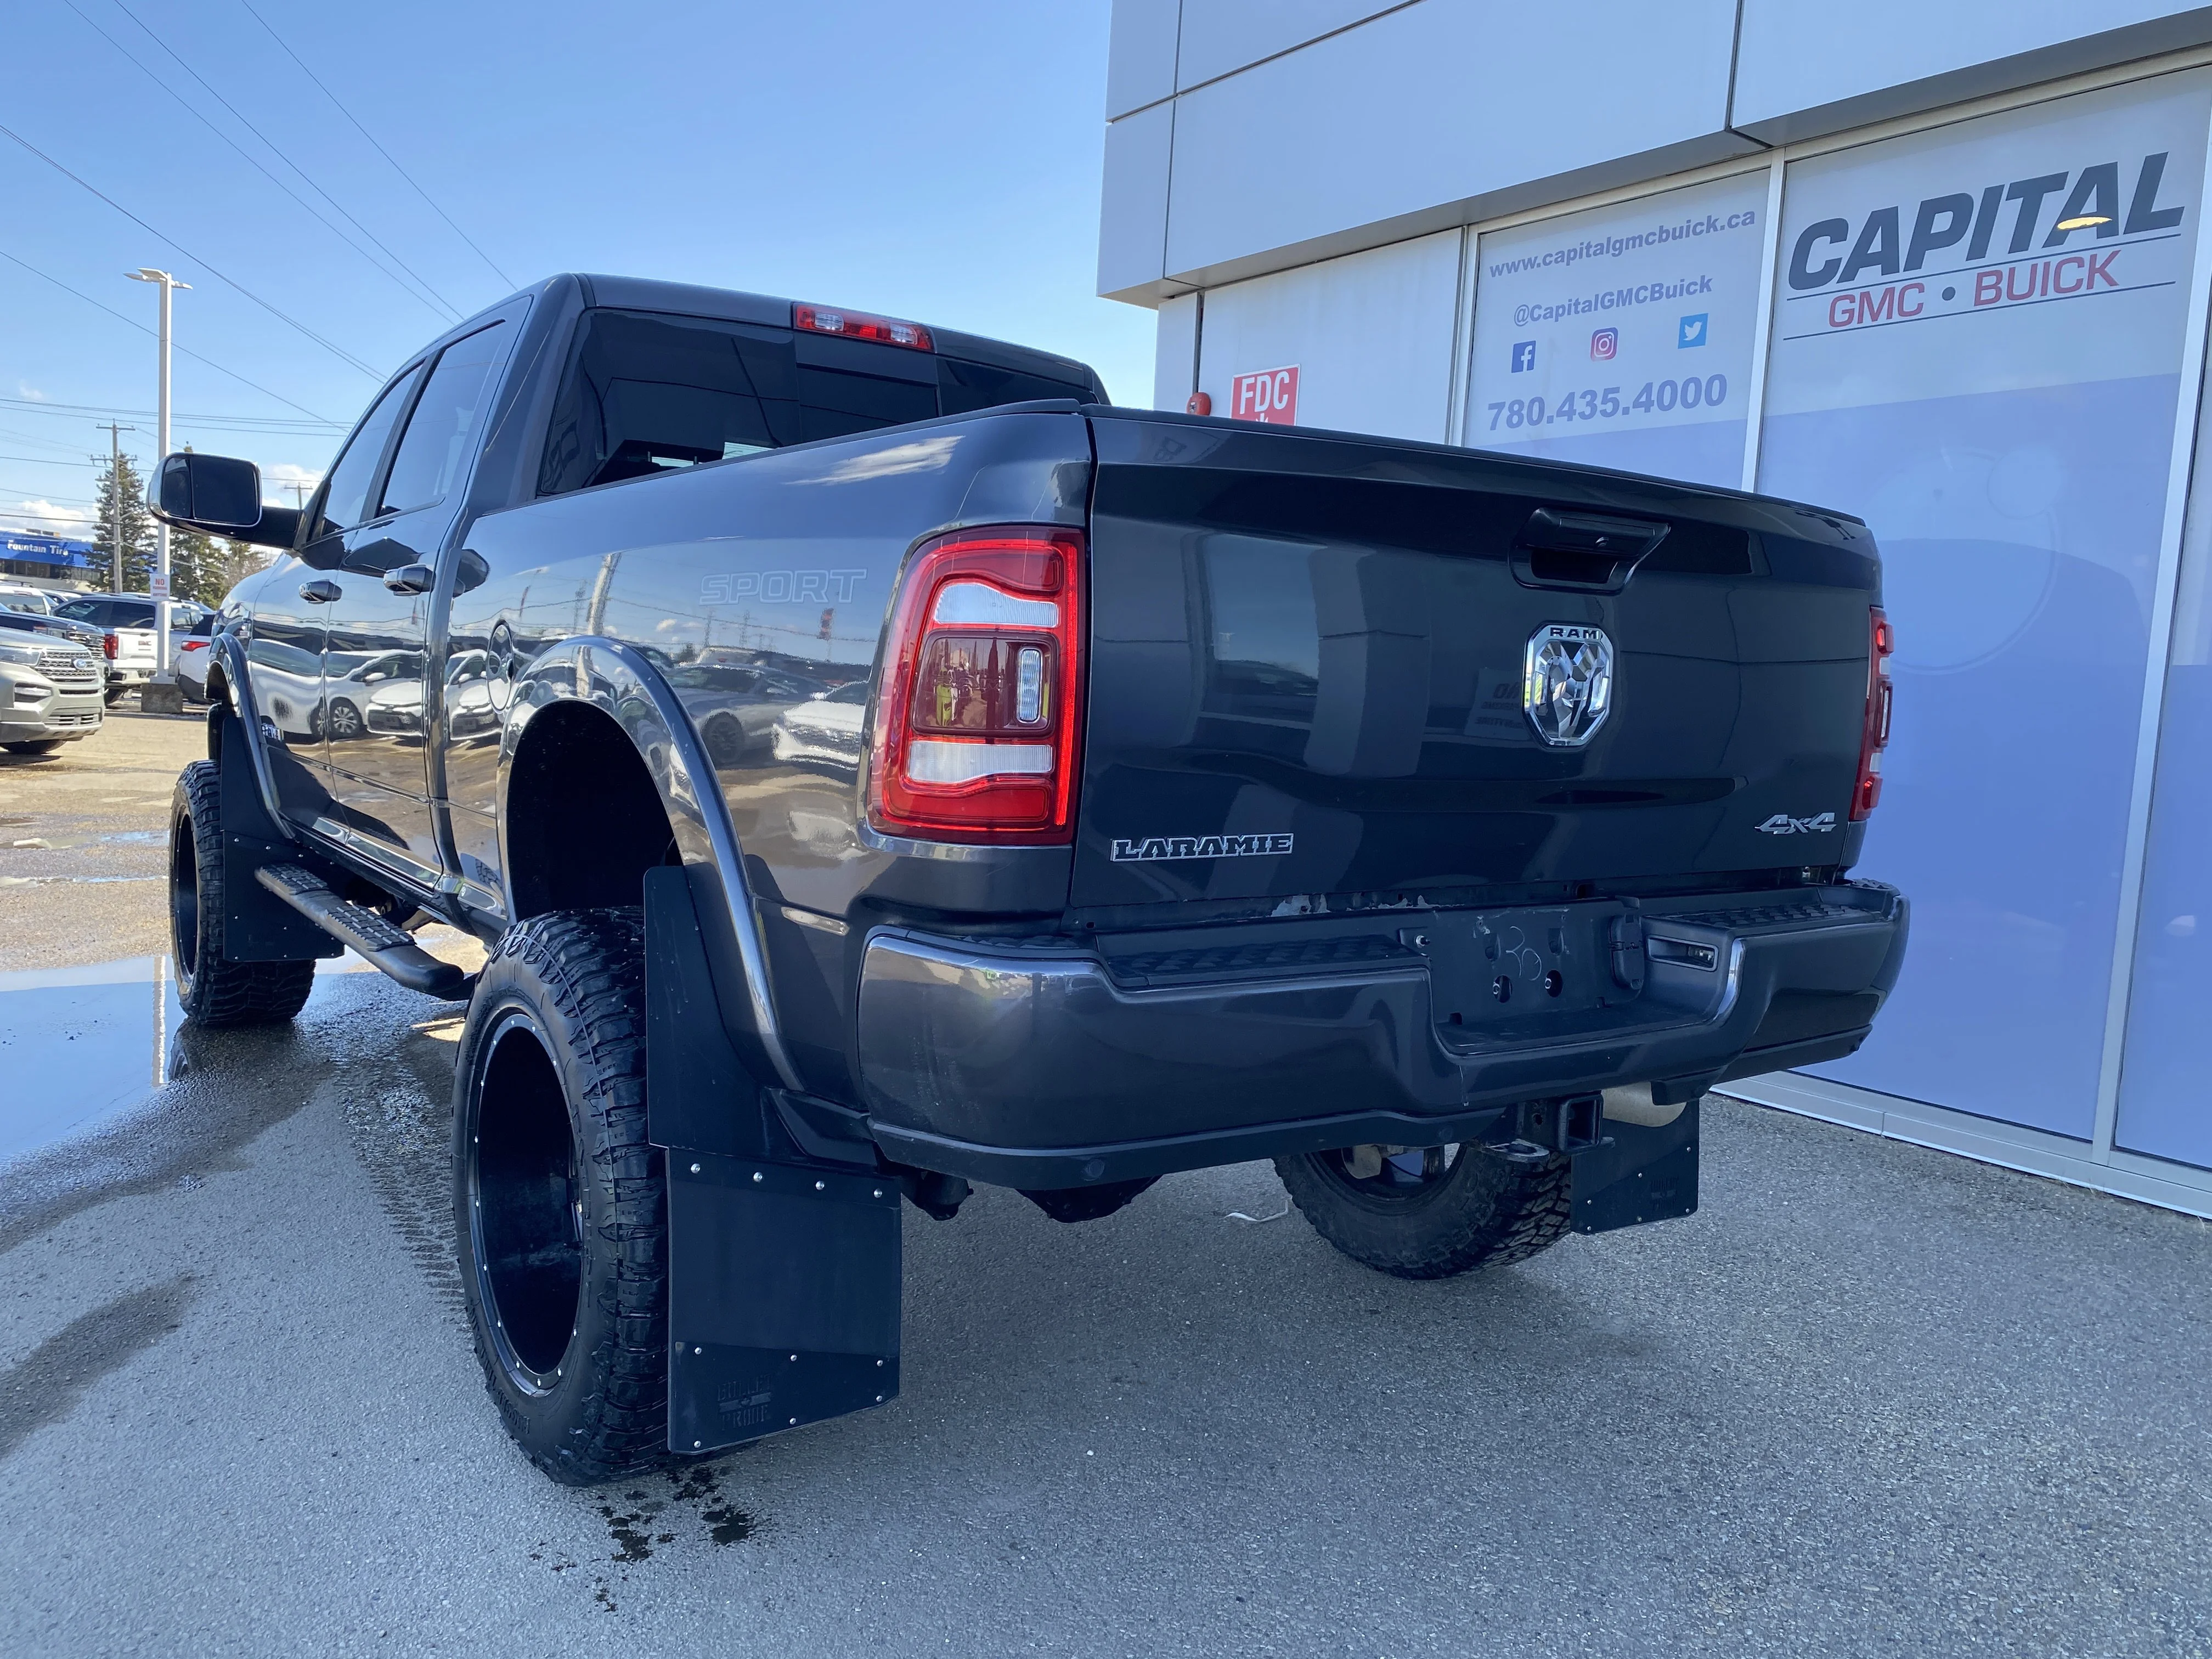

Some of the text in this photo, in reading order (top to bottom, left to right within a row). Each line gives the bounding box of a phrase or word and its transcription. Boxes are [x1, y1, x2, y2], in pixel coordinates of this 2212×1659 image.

[1787, 151, 2185, 291] CAPITAL
[1489, 211, 1756, 278] www.capitalgmcbuick.ca
[1514, 274, 1713, 327] @CapitalGMCBuick
[1829, 250, 2123, 328] GMC BUICK
[1239, 371, 1290, 415] FDC
[1488, 374, 1728, 431] 780.435.4000
[7, 540, 69, 556] Fountain Tire
[699, 568, 868, 605] SPORT
[1549, 627, 1600, 640] RAM
[1754, 812, 1837, 834] 4x4
[1110, 833, 1294, 862] LARAMIE
